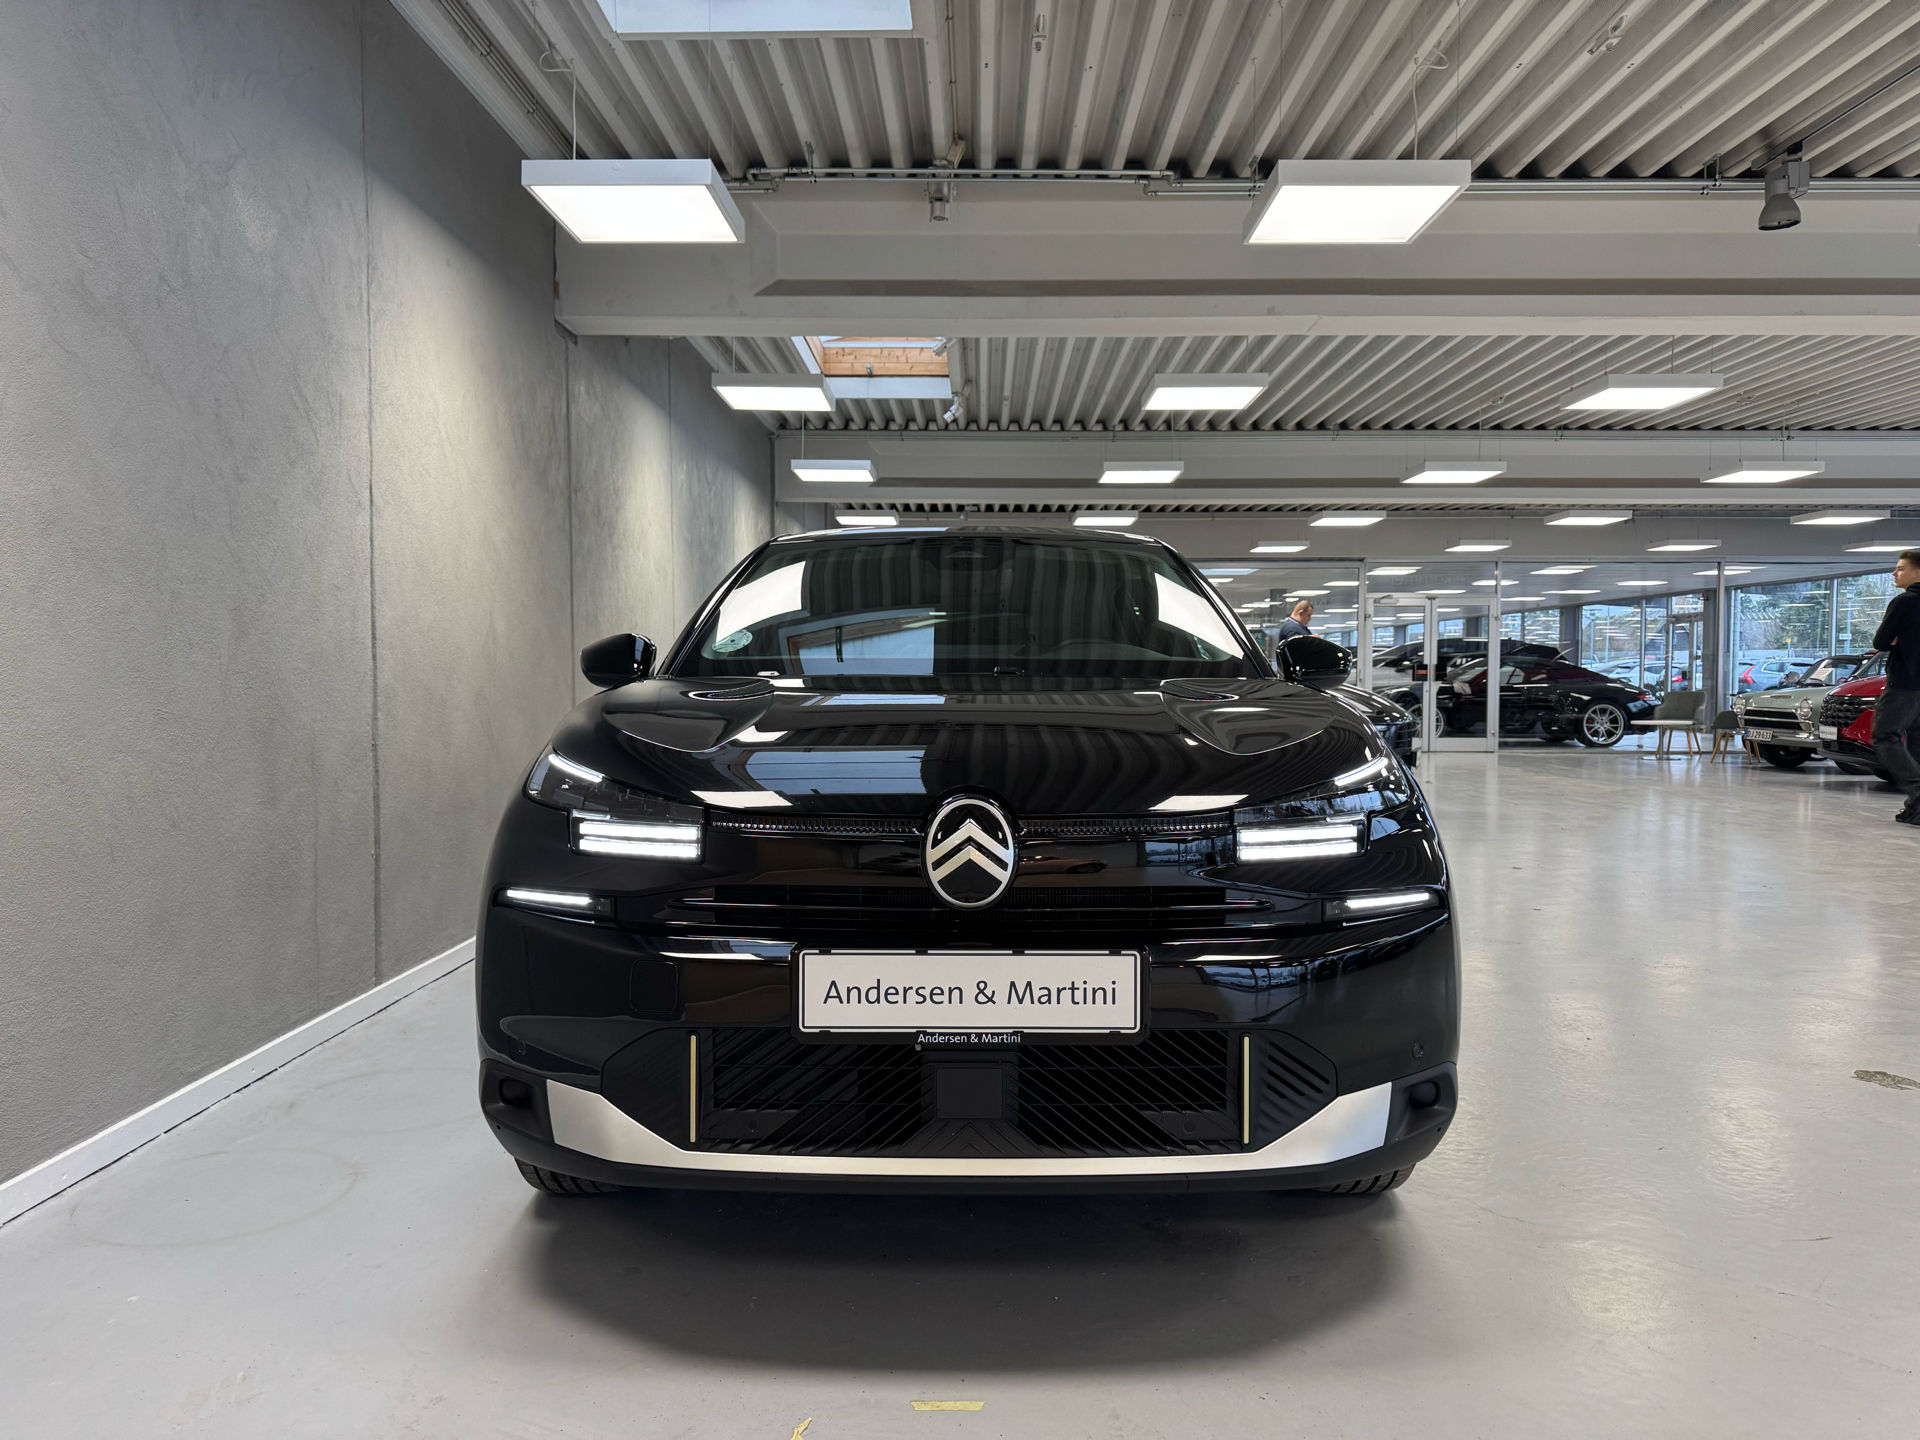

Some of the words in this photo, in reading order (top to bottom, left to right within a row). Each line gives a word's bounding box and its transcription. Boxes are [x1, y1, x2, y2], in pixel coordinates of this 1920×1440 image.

[823, 978, 964, 1005] Andersen
[974, 980, 997, 1005] &
[1006, 980, 1117, 1005] Martini
[917, 1033, 967, 1043] Andersen
[970, 1033, 979, 1043] &
[981, 1033, 1021, 1043] Martini
